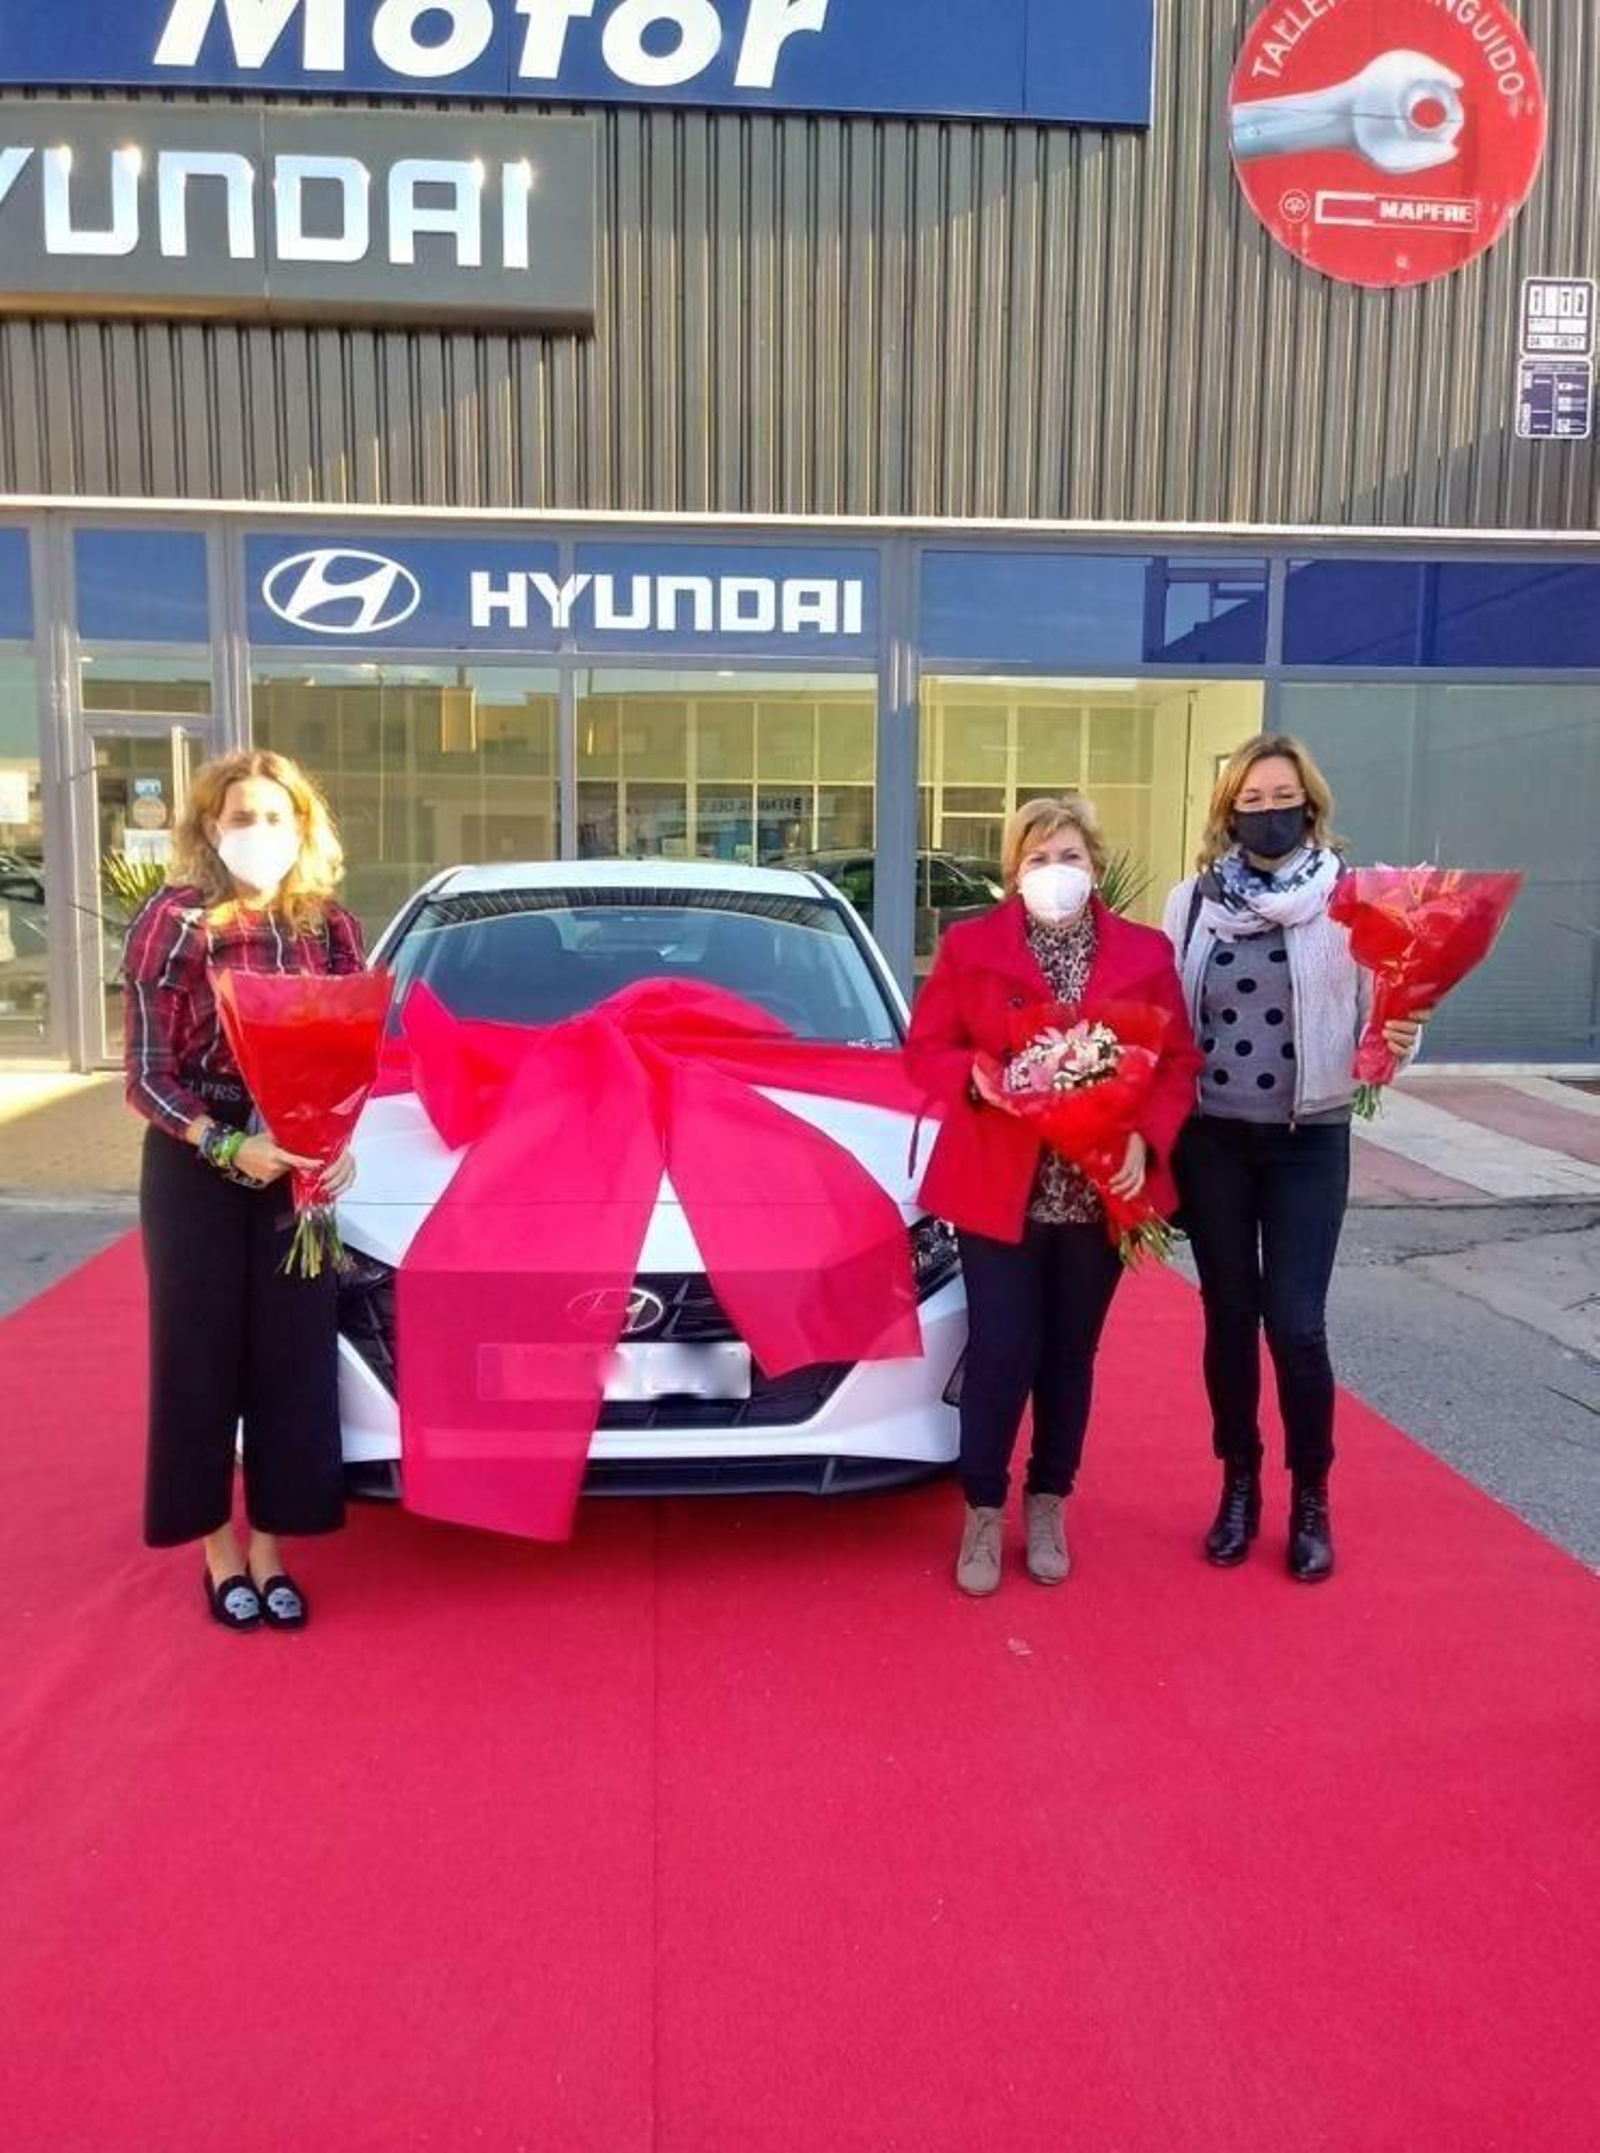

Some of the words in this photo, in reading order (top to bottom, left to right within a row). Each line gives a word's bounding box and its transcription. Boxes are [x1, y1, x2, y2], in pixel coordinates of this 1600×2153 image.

[153, 0, 829, 88] Motor
[1252, 0, 1336, 78] TALLE
[1427, 0, 1525, 95] GUIDO
[0, 145, 533, 269] UNDAI
[1379, 200, 1472, 223] MAPFRE
[470, 572, 863, 634] HYUNDAI
